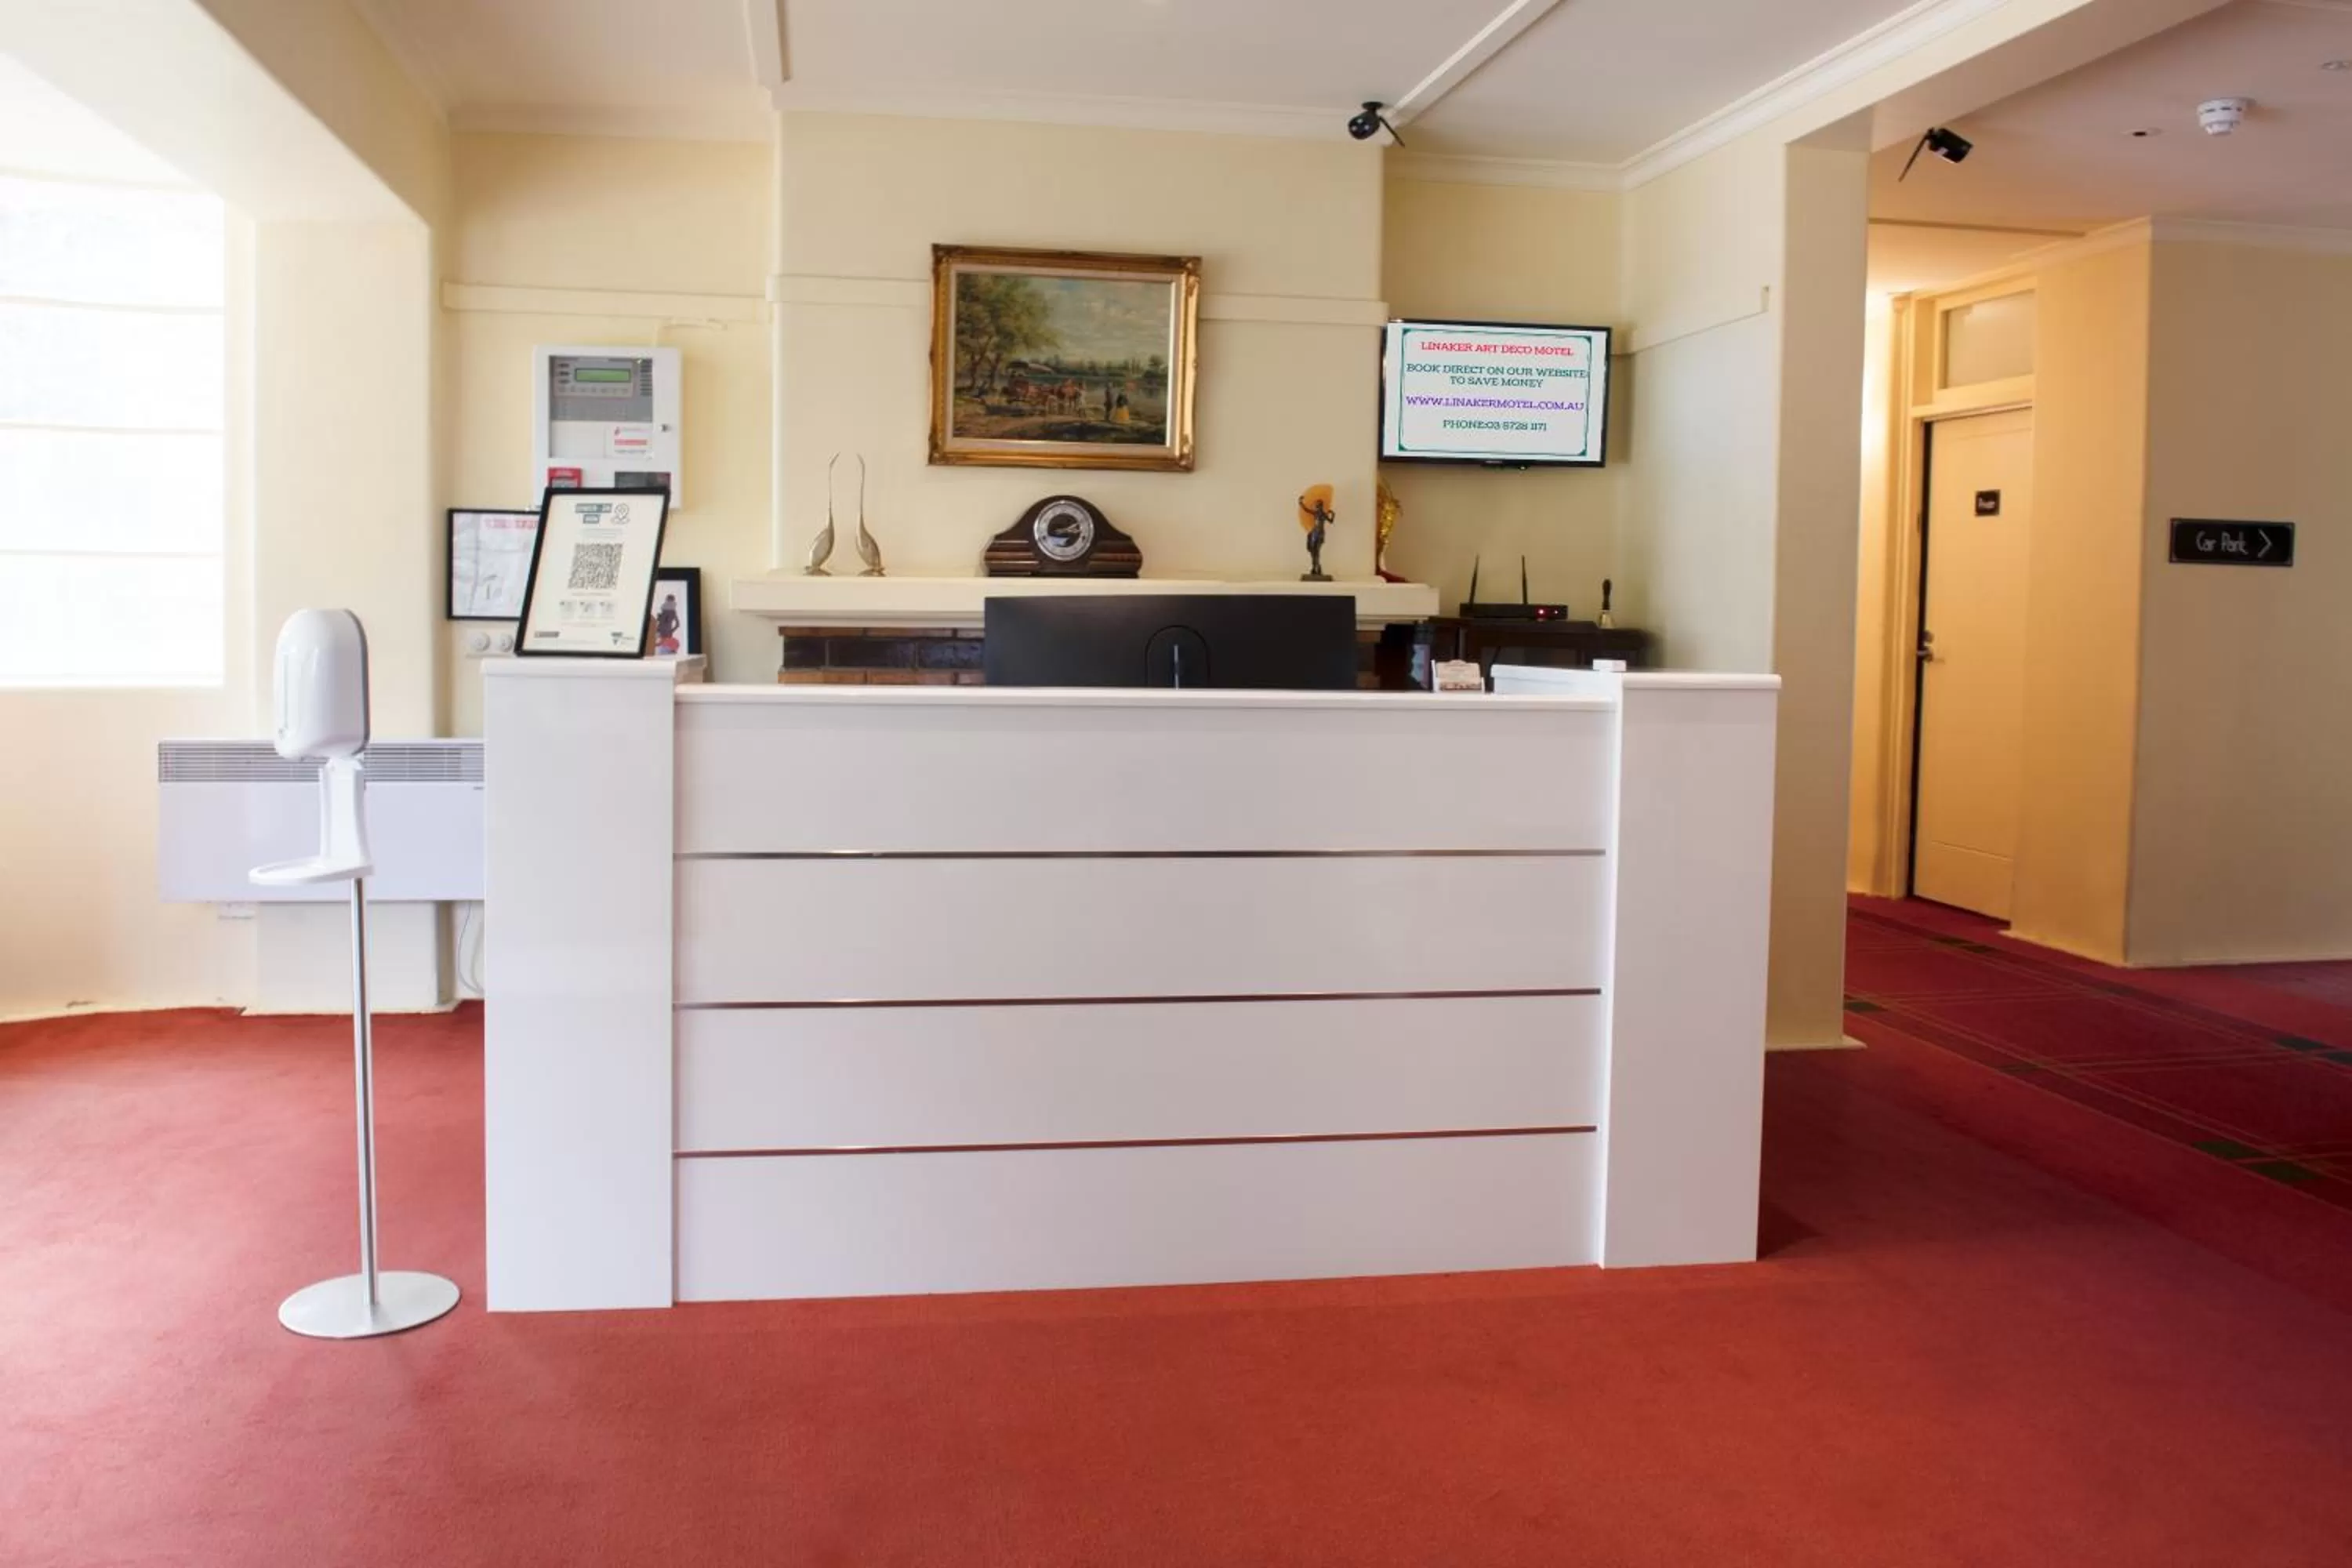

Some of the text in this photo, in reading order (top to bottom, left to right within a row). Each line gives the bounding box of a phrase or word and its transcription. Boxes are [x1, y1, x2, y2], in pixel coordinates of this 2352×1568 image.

[1421, 341, 1473, 352] LINAKER
[1475, 344, 1497, 354] ART
[1534, 347, 1573, 356] MOTEL
[1406, 363, 1441, 373] BOOK
[1443, 365, 1485, 374] DIRECT
[1486, 366, 1504, 376] ON
[1506, 367, 1533, 376] OUR
[1450, 376, 1543, 388] TO SAVE MONEY
[1406, 396, 1584, 410] WWW.LINAKERMOTEL.COM.AU
[2196, 530, 2249, 555] Car Park
